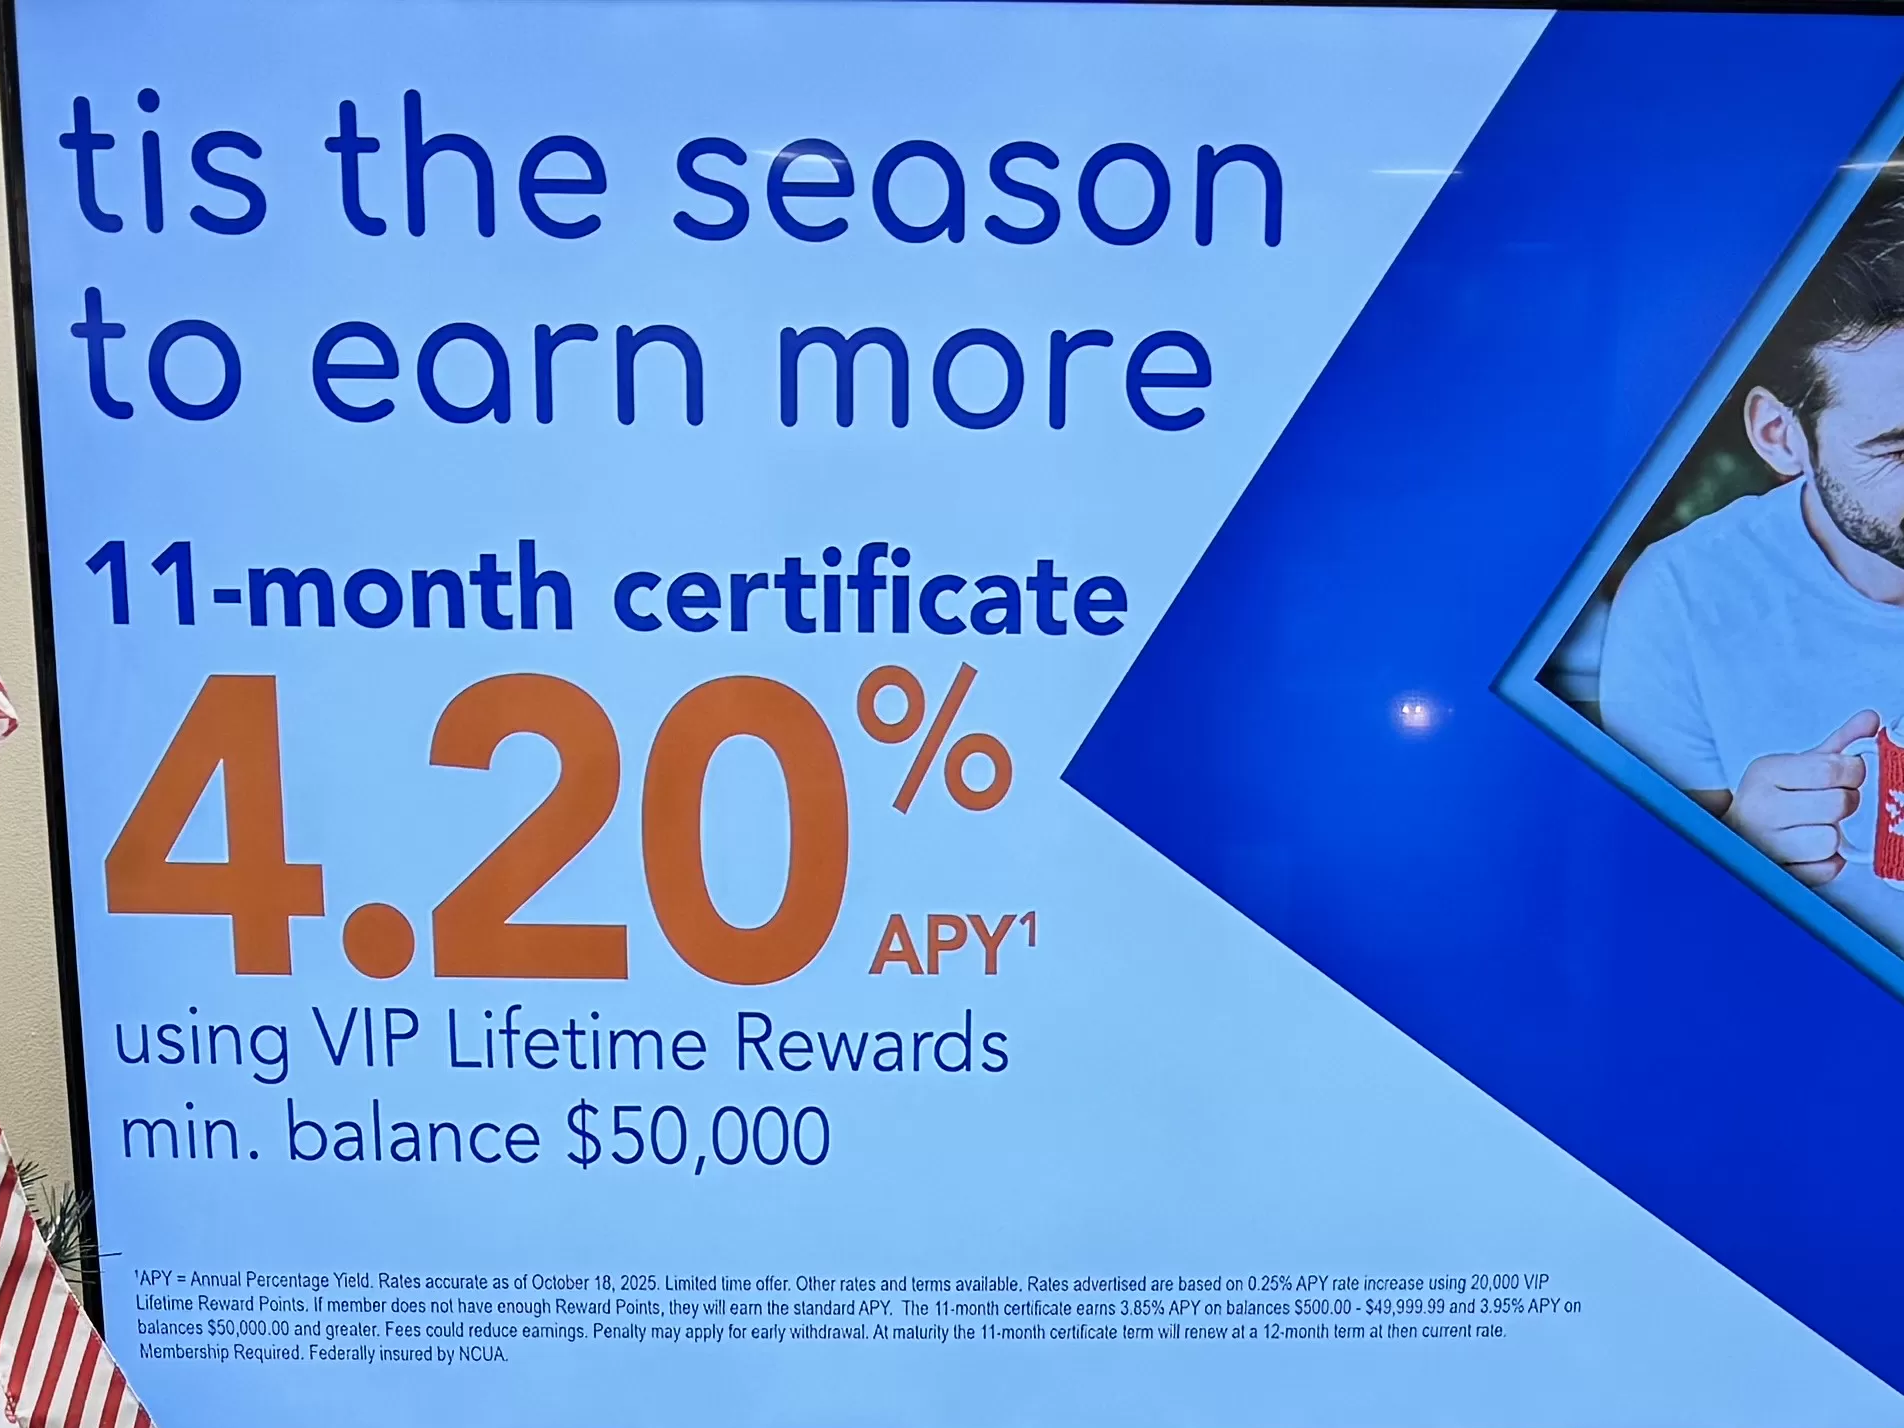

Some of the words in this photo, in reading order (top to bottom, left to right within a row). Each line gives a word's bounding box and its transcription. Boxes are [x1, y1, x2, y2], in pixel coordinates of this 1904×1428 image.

[59, 88, 266, 235] tis
[325, 89, 607, 239] the
[674, 137, 1282, 247] season
[71, 287, 241, 421] to
[313, 321, 703, 426] earn
[780, 327, 1211, 431] more
[86, 539, 572, 630] 11-month
[614, 542, 1129, 638] certificate
[116, 1007, 288, 1084] using
[312, 1007, 418, 1067] VIP
[449, 1004, 707, 1070] Lifetime
[738, 1009, 1008, 1072] Rewards
[123, 1102, 258, 1160] min.
[287, 1098, 539, 1164] balance
[568, 1098, 829, 1175] $50,000
[191, 1271, 241, 1286] Annual
[247, 1272, 329, 1292] Percentage
[333, 1272, 373, 1289] Yield.
[379, 1273, 420, 1288] Rates
[425, 1273, 488, 1289] accurate
[493, 1278, 509, 1289] as
[514, 1274, 528, 1289] of
[532, 1274, 589, 1290] October
[595, 1275, 615, 1293] 18,
[621, 1275, 659, 1291] 2025.
[666, 1275, 716, 1291] Limited
[722, 1276, 751, 1291] time
[756, 1275, 791, 1291] offer.
[140, 1344, 229, 1363] Membership
[234, 1344, 304, 1364] Required.
[310, 1344, 375, 1363] Federally
[380, 1345, 432, 1361] insured
[437, 1346, 454, 1365] by
[460, 1346, 508, 1362] NCUA.
